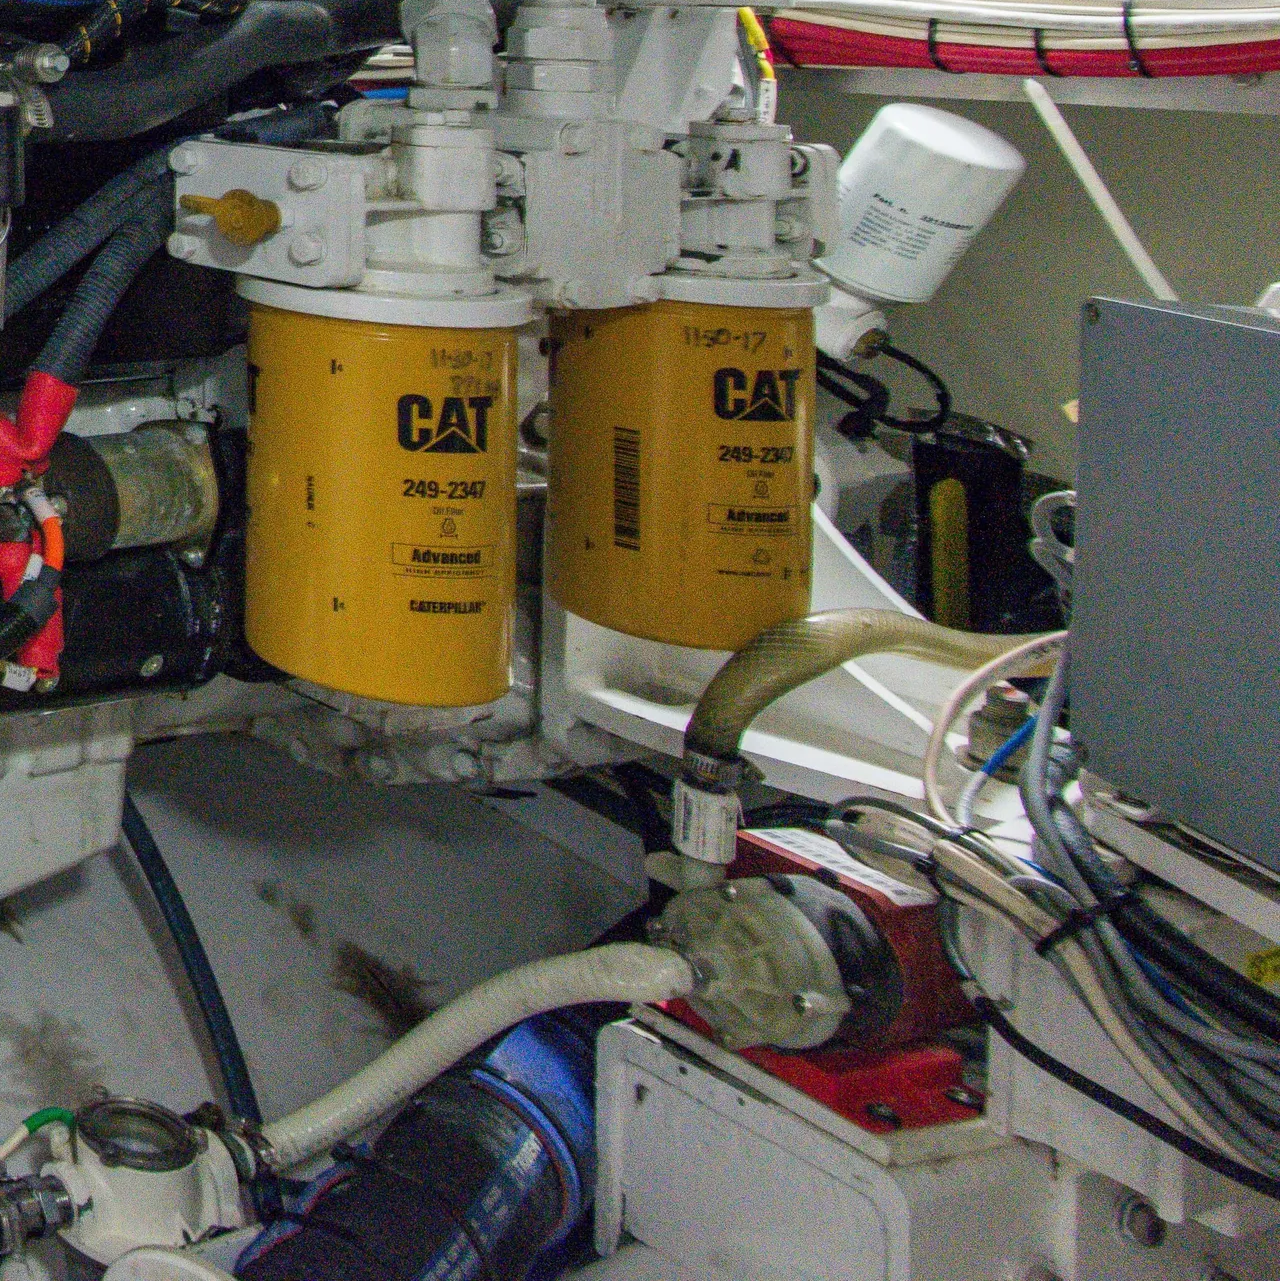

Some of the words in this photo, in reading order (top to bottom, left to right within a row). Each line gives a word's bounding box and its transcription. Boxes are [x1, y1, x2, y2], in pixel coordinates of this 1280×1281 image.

[713, 367, 802, 422] CAT
[397, 393, 494, 453] CAT
[718, 445, 794, 464] 249-2347
[403, 479, 487, 500] 249-2347
[412, 548, 482, 565] Advanced
[409, 599, 482, 615] CATERPILLAR
